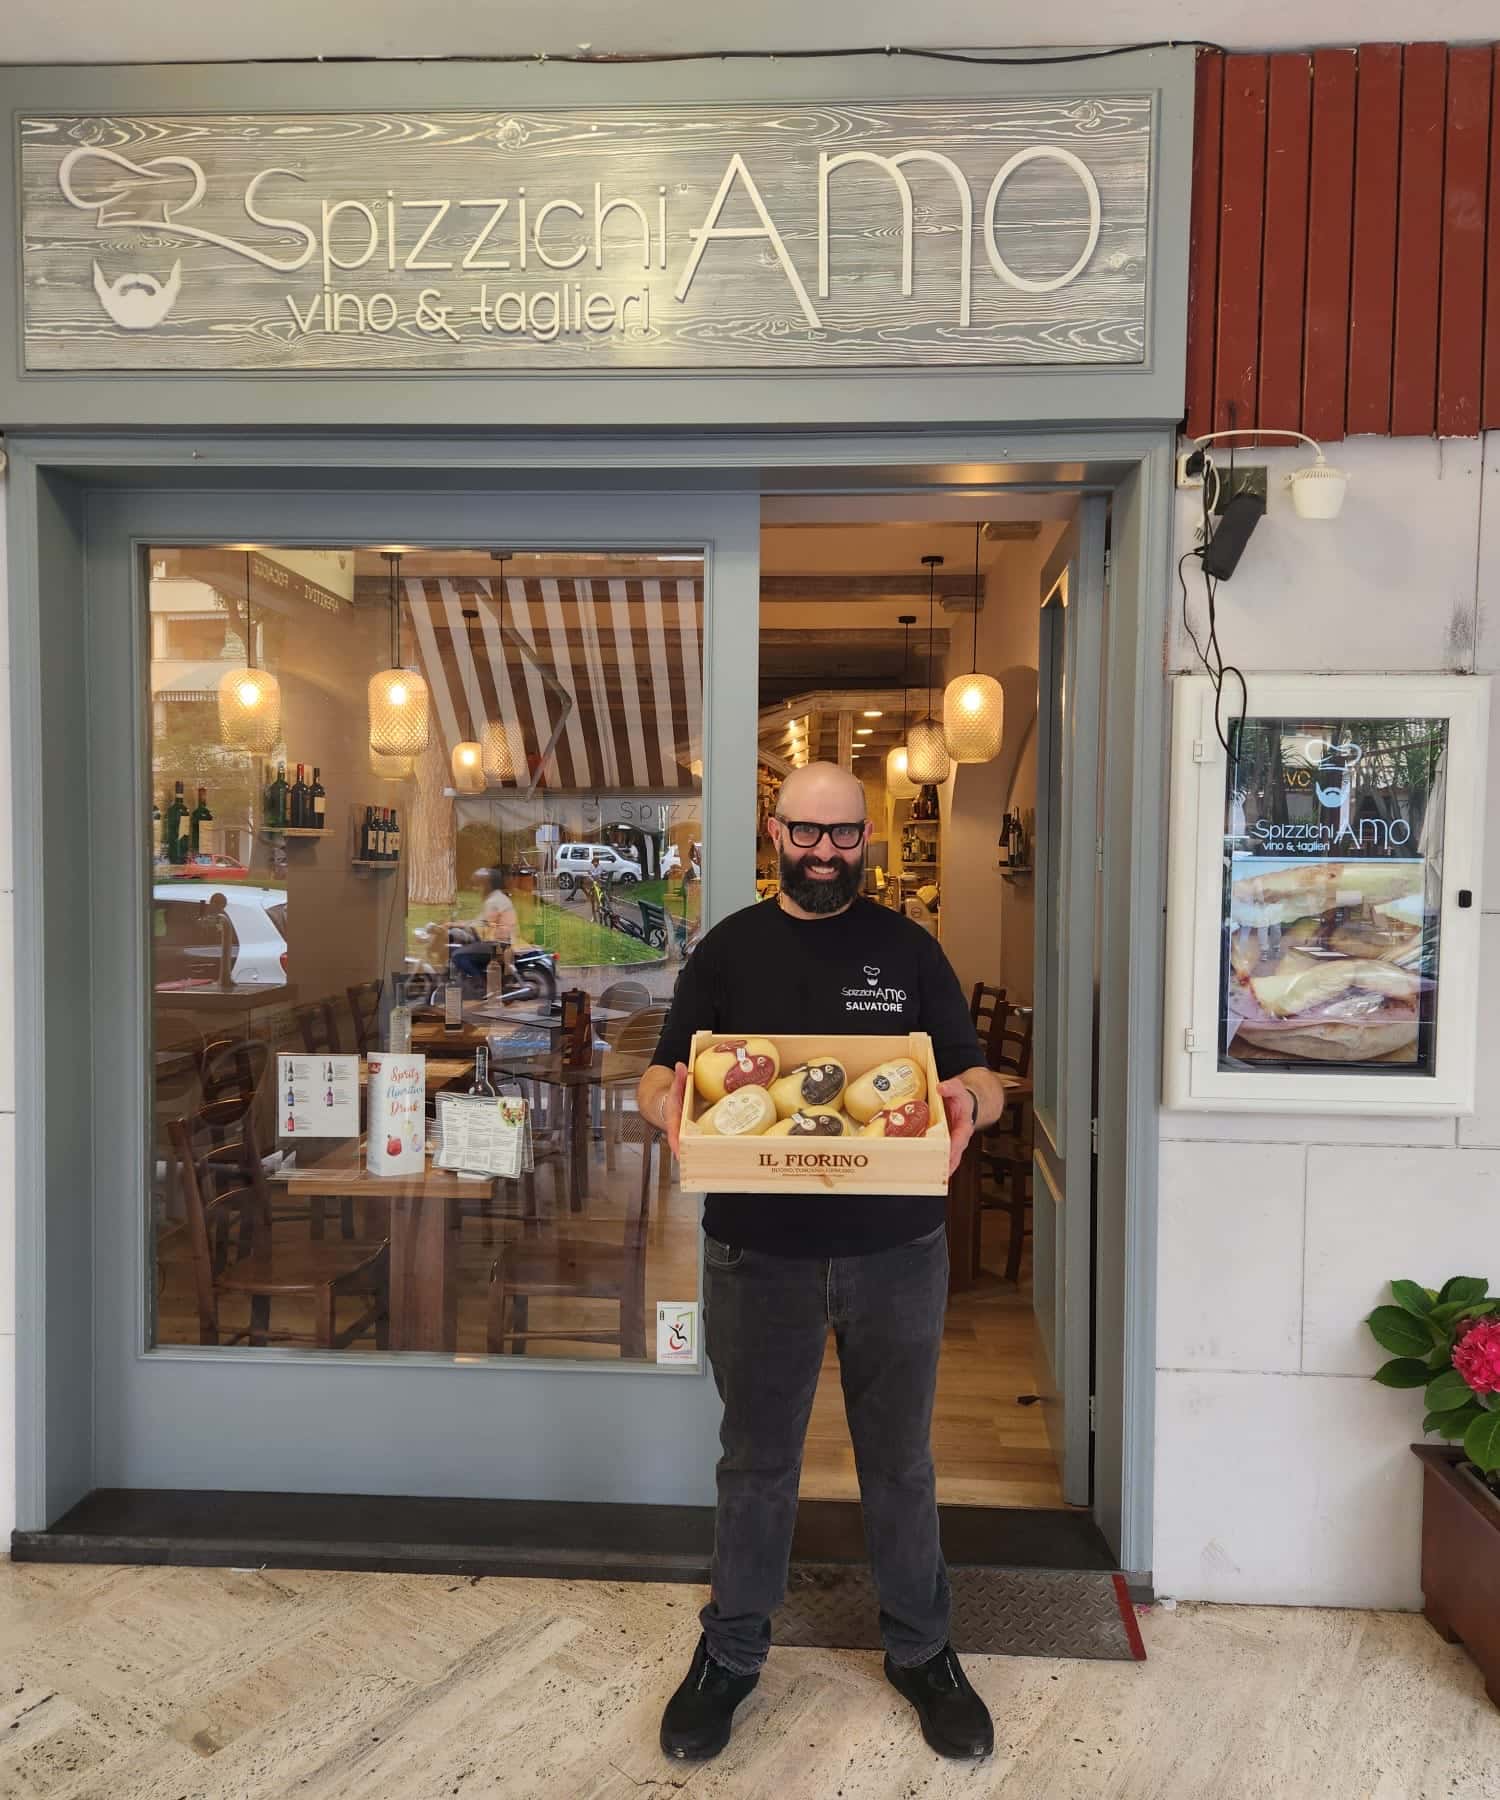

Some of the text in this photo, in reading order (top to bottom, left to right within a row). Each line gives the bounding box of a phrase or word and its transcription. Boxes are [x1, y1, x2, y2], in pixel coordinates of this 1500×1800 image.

[286, 281, 651, 342] vino & taglieri
[1263, 841, 1284, 851] vino
[1297, 840, 1330, 853] taglieri
[845, 1001, 903, 1012] SALVATORE
[759, 1153, 869, 1168] IL FIORINO
